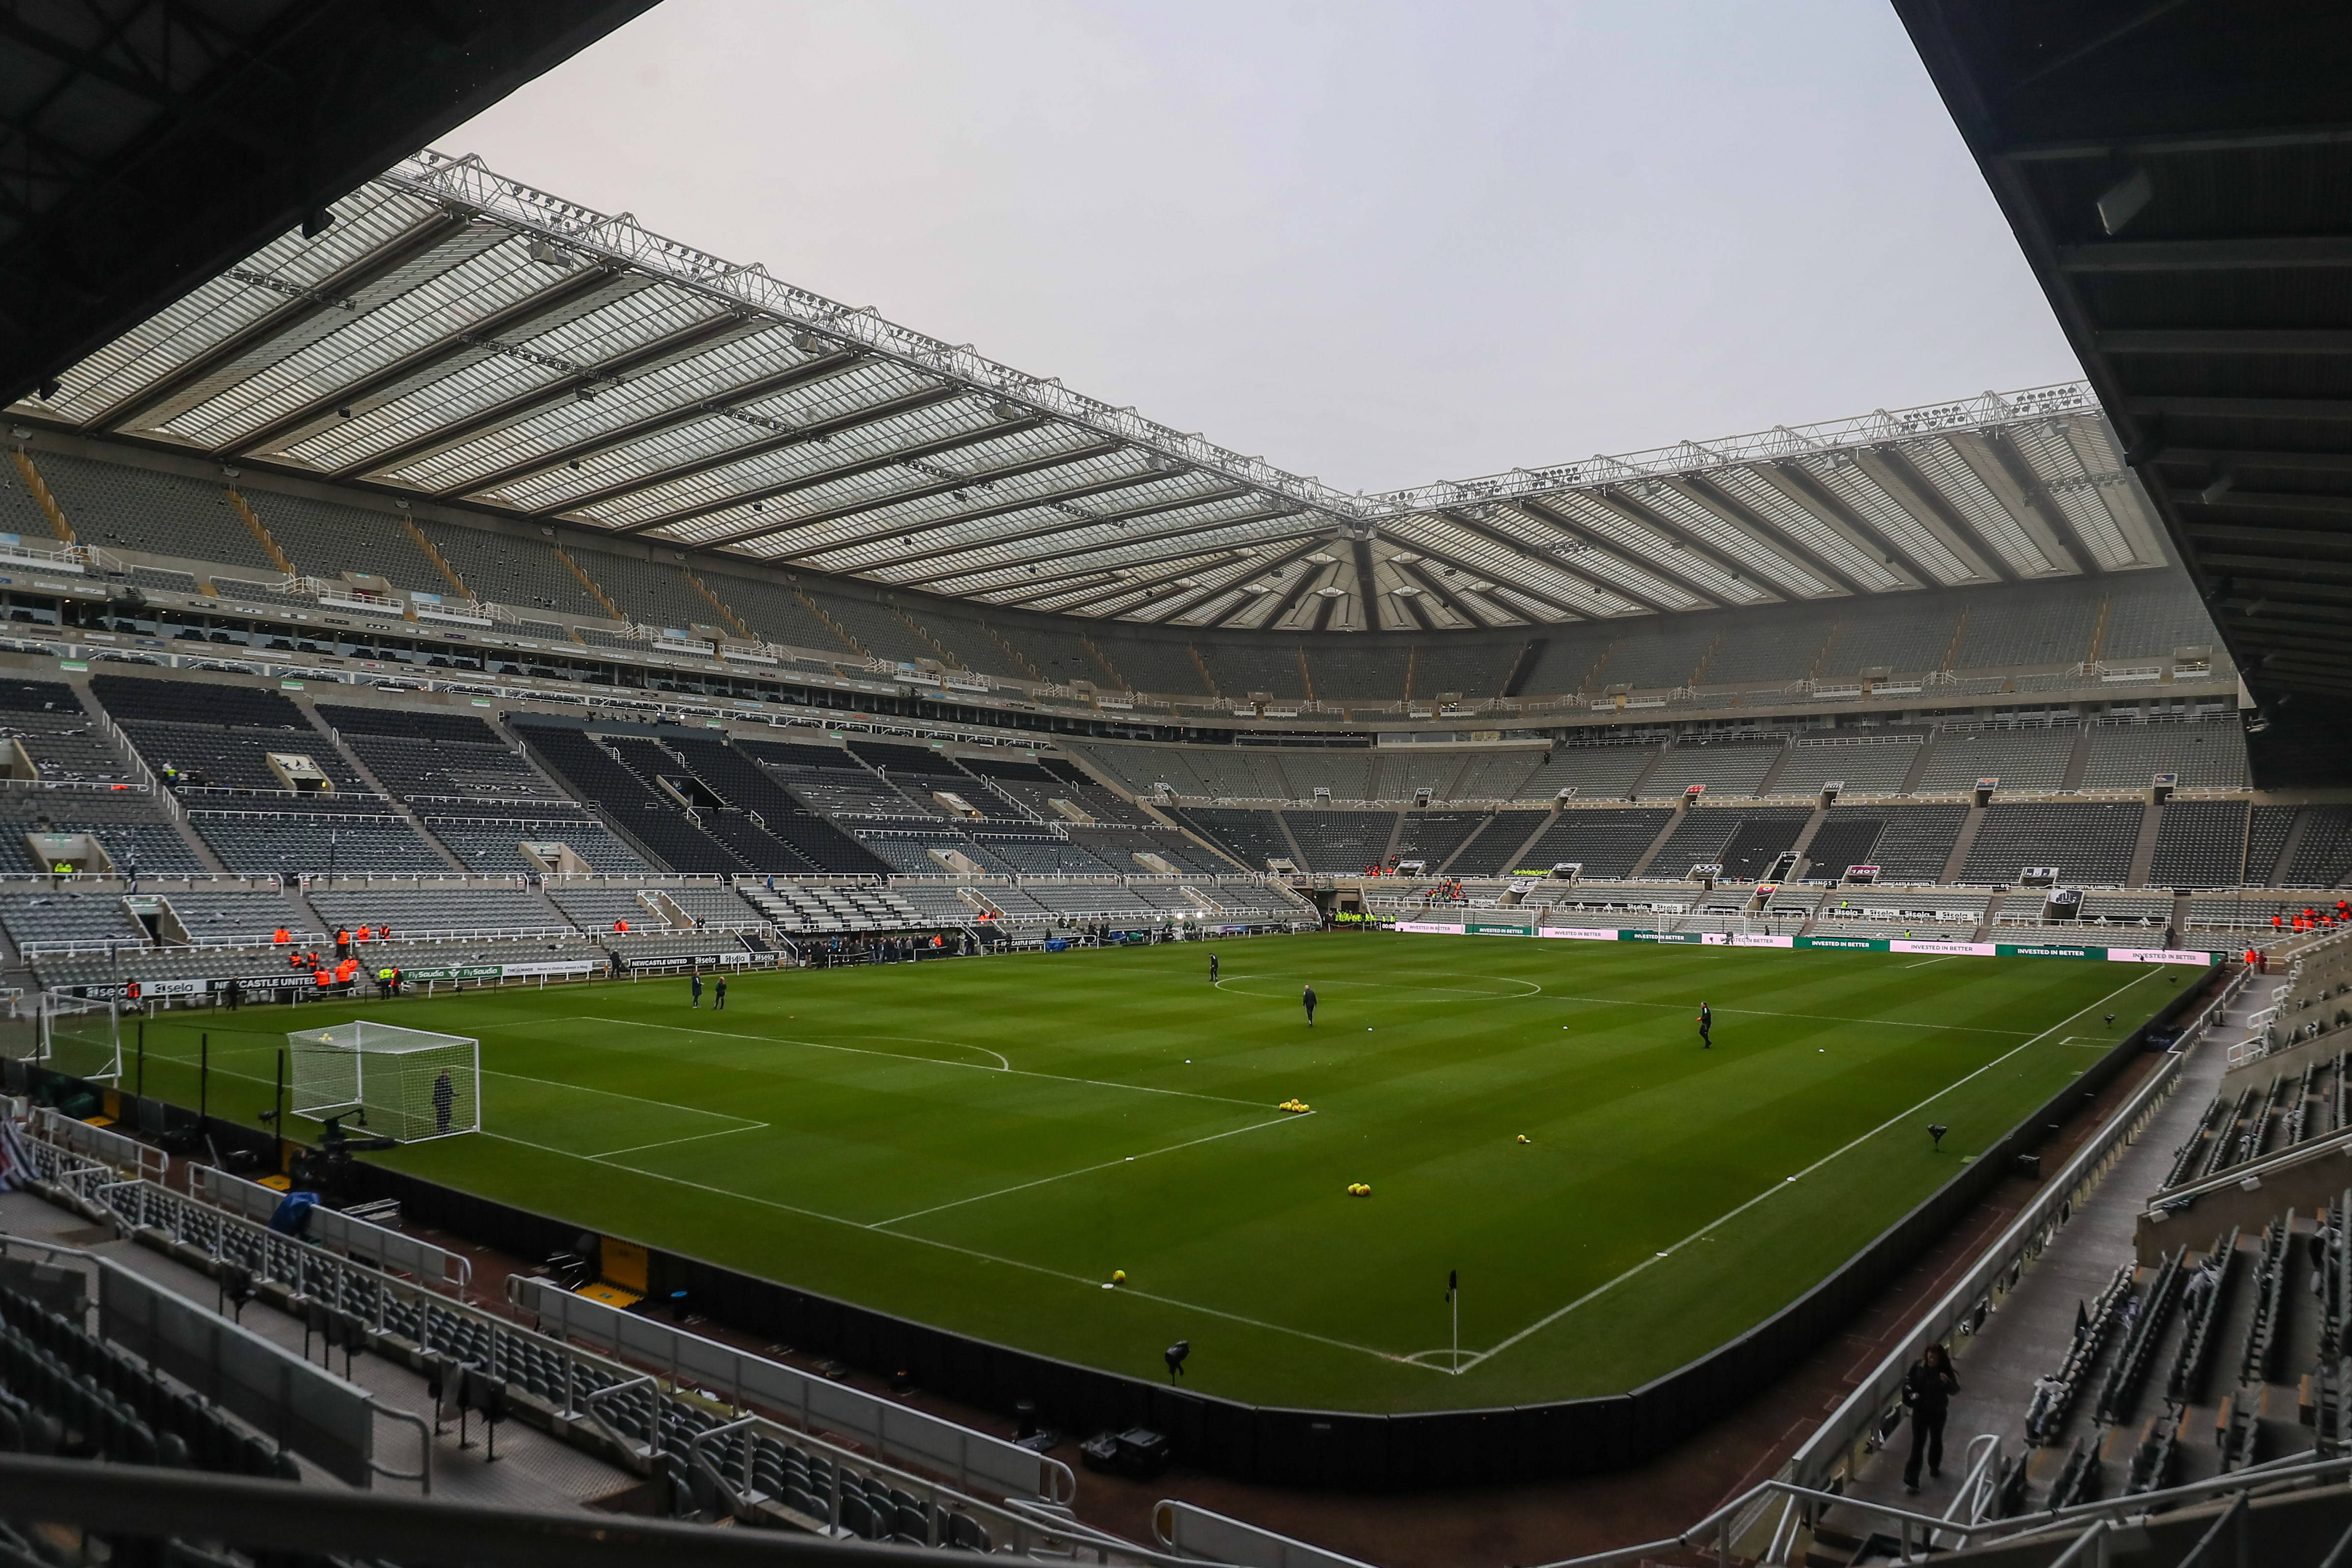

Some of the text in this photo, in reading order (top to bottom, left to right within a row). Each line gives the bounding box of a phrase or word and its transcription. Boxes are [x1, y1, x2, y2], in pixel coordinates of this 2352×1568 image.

[168, 983, 194, 993] sela
[214, 976, 317, 990] NECASTLE UNITED
[99, 987, 128, 997] sea
